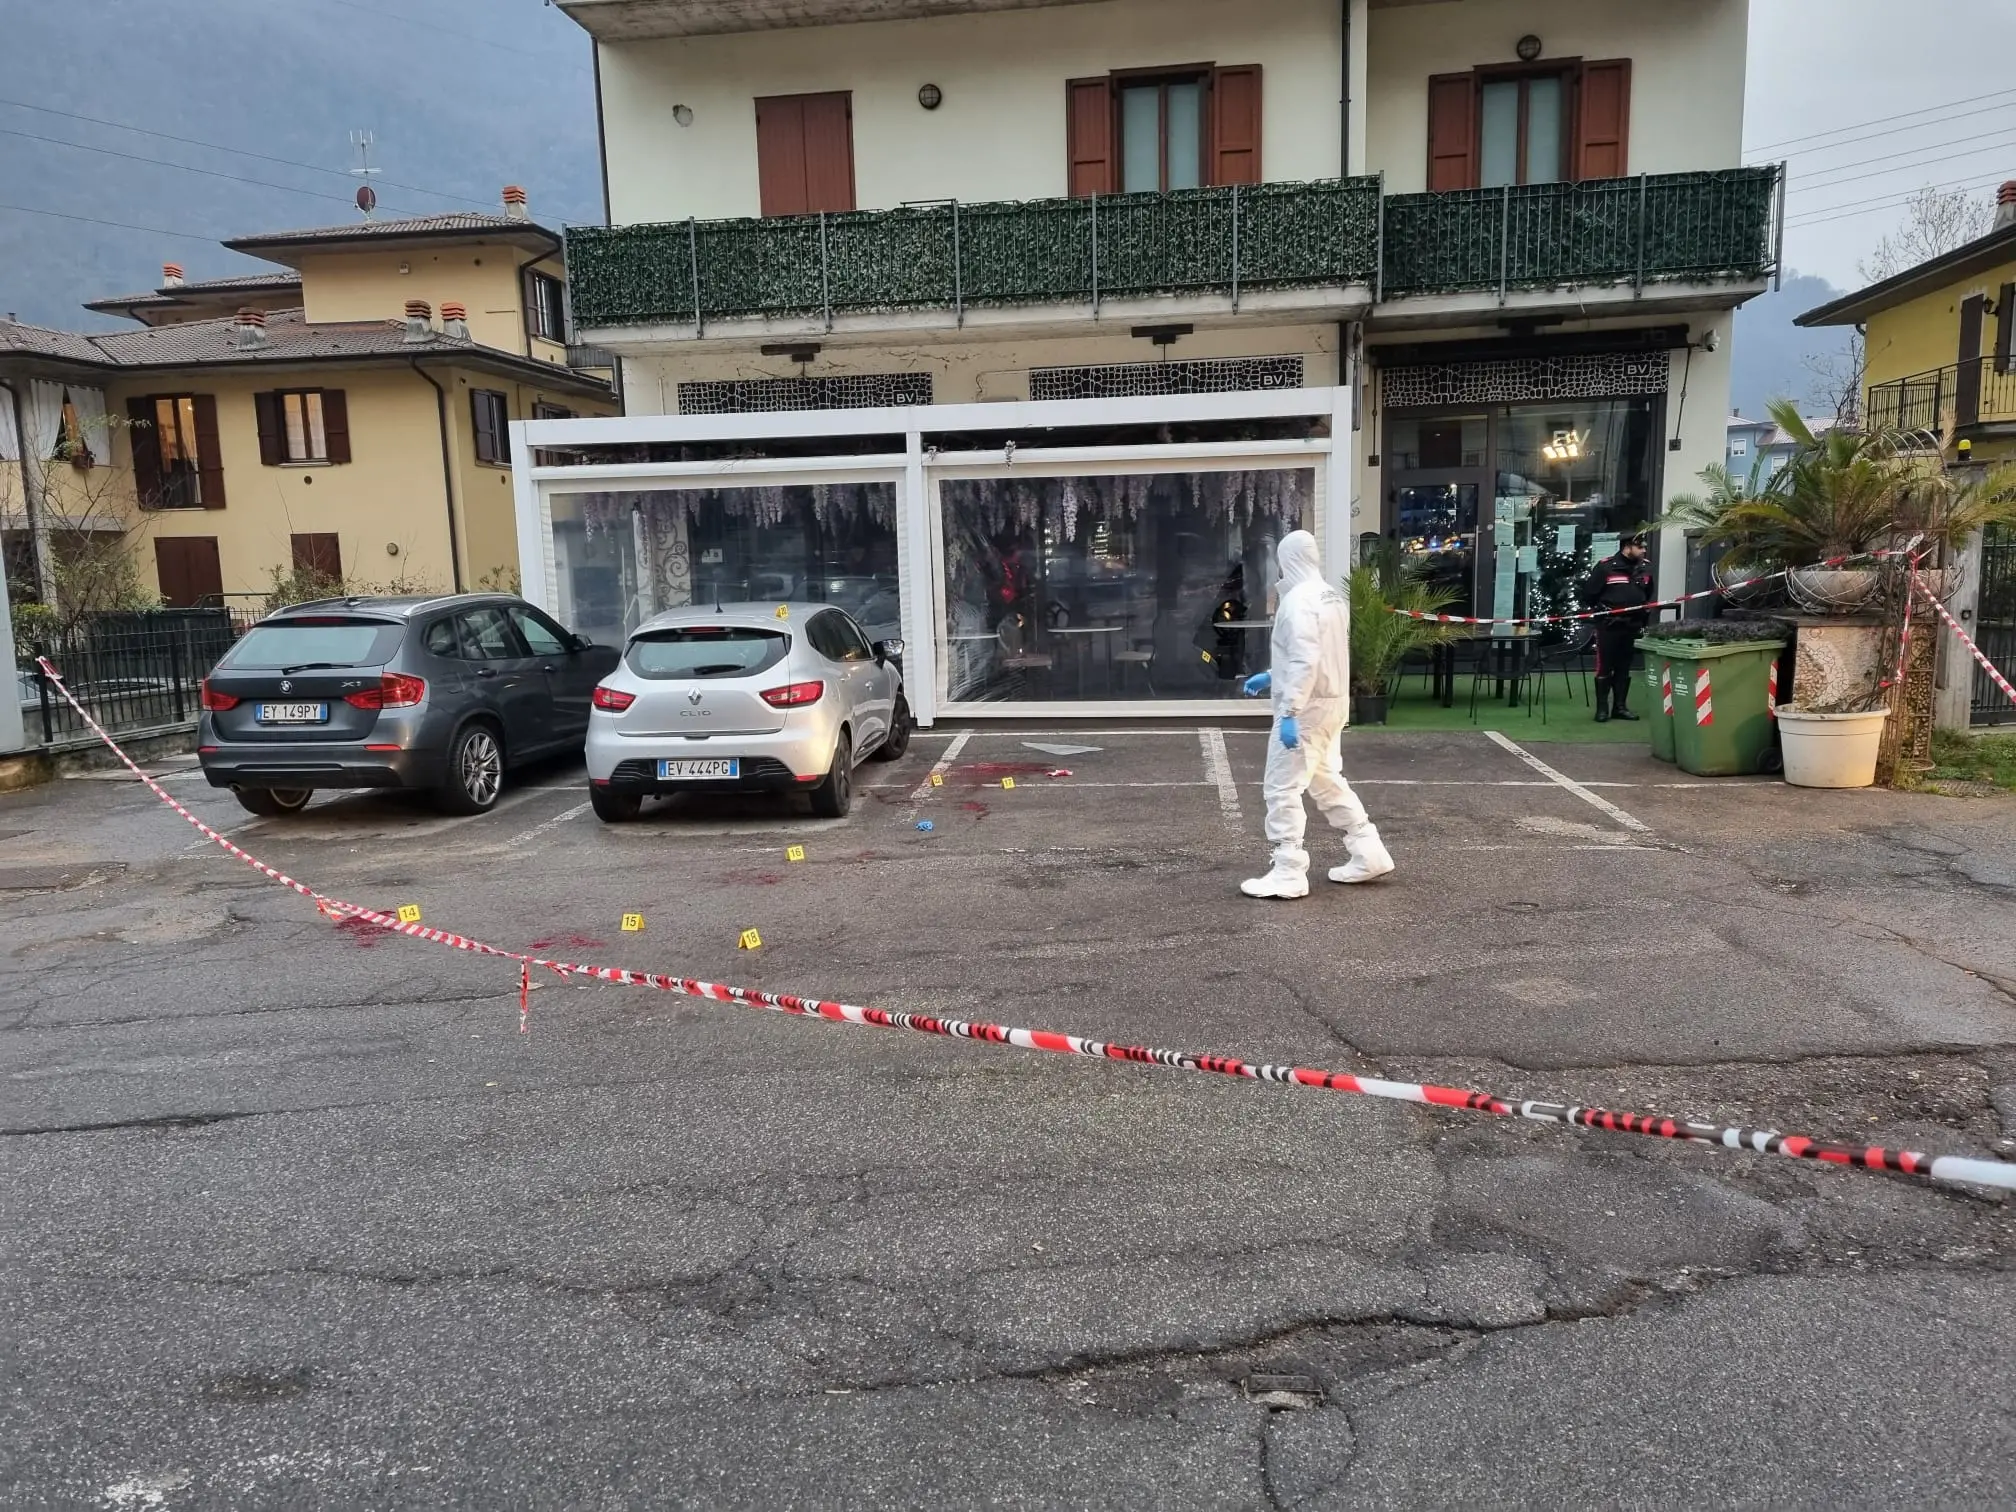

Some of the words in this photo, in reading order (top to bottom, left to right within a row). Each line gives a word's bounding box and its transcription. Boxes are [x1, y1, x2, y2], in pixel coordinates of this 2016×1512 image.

[1627, 364, 1647, 375] BV
[1264, 375, 1283, 385] BV
[896, 393, 914, 403] BV
[263, 705, 278, 719] EY
[283, 705, 318, 719] 149PY
[668, 761, 683, 776] EV
[689, 761, 729, 775] 444PG
[790, 847, 802, 857] 16
[401, 907, 416, 918] 14
[624, 916, 637, 927] 15
[746, 931, 758, 943] 18
